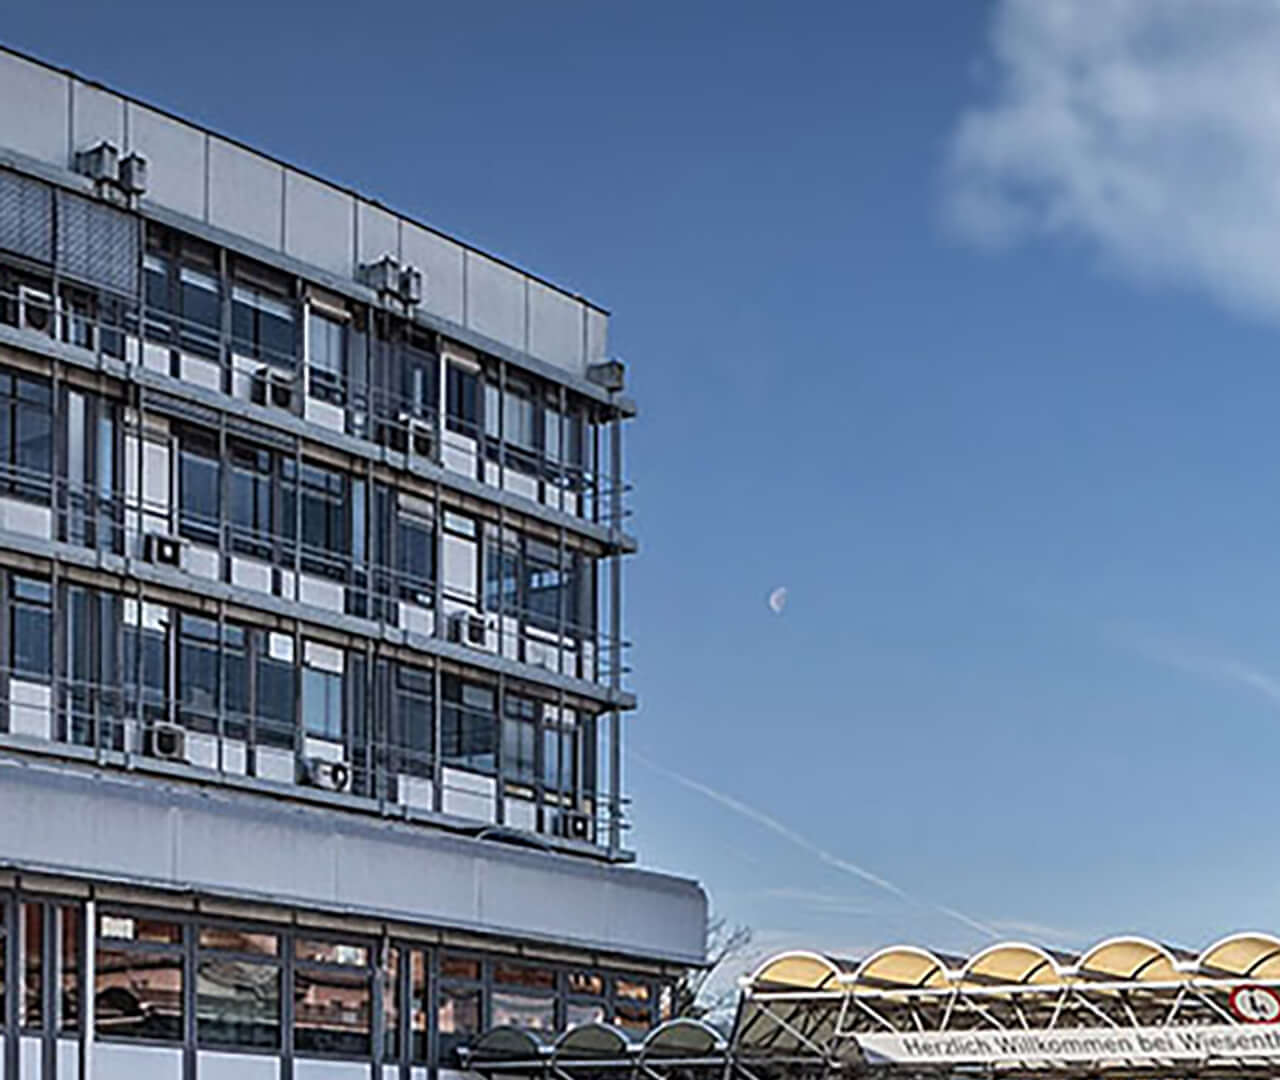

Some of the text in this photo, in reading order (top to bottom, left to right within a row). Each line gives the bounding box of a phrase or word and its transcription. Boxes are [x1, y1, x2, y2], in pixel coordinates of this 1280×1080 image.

[902, 1034, 991, 1057] Herzlich
[993, 1032, 1132, 1056] Willkommen
[1137, 1030, 1175, 1052] bei
